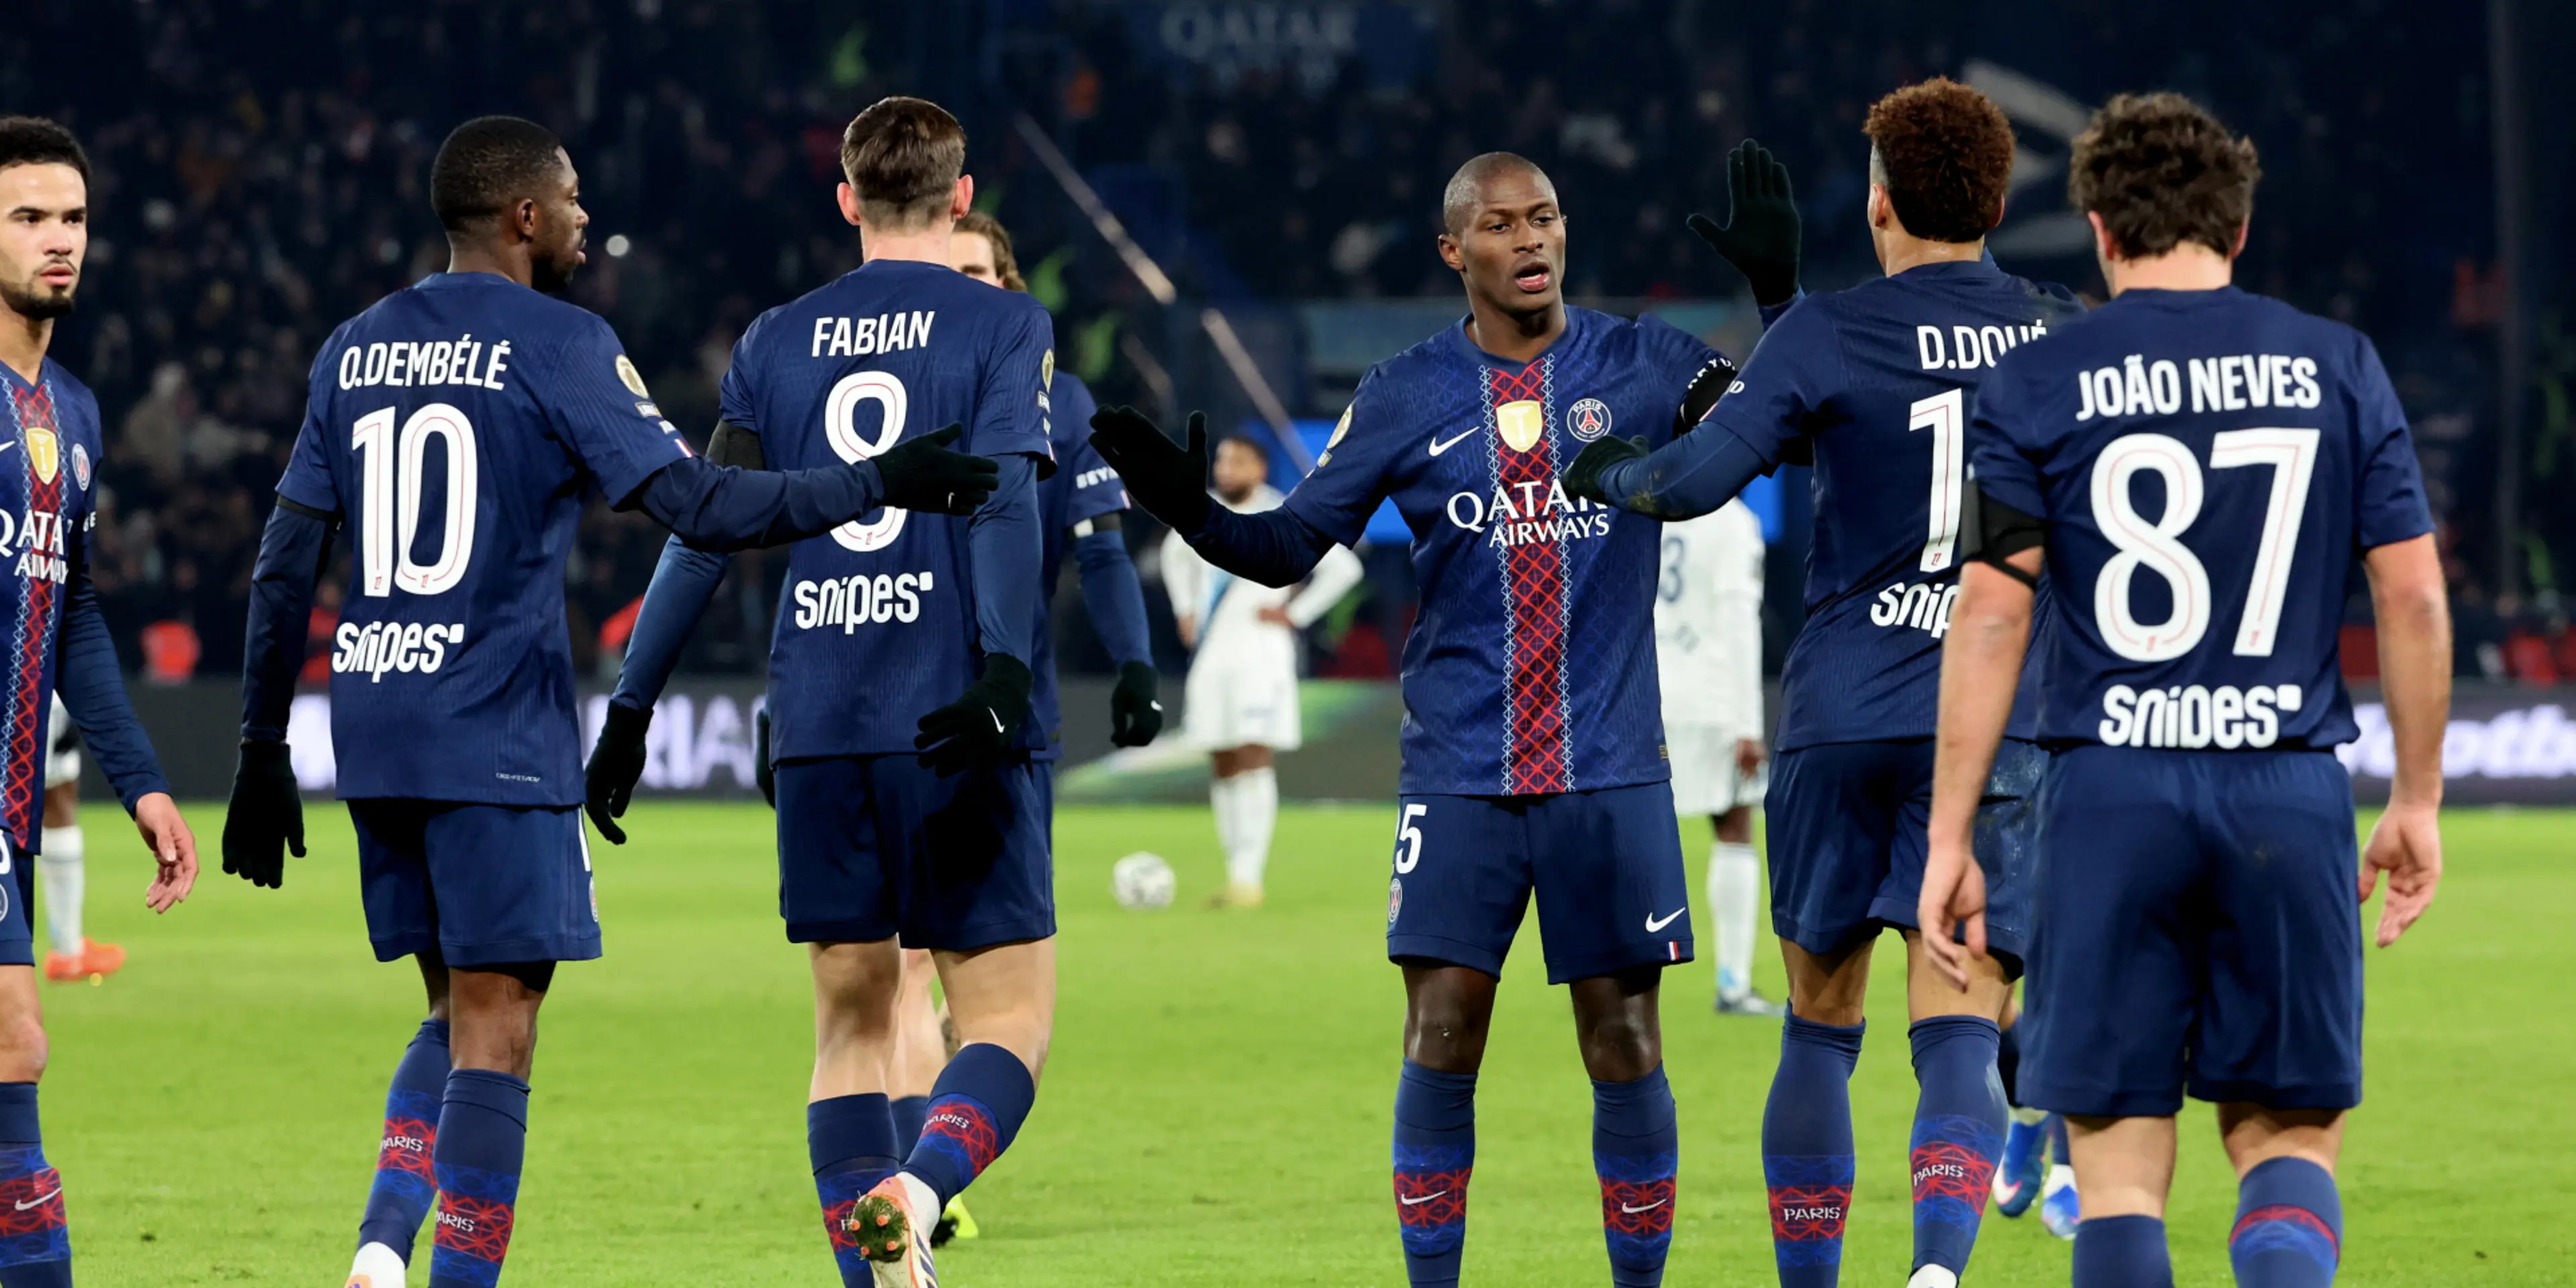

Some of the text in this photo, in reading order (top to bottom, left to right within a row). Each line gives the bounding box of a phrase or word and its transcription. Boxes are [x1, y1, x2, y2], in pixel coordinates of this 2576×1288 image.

[339, 333, 511, 390] O.DEMBÉLÉ
[812, 311, 935, 357] FABIAN
[2076, 354, 2320, 421] JOÃO NEVES
[824, 370, 908, 552] 8
[352, 402, 478, 597] 10
[1488, 513, 1610, 548] AIRWAYS
[2090, 427, 2320, 662] 87
[1870, 581, 1962, 639] snip
[1391, 804, 1428, 874] 5
[1913, 1164, 1964, 1187] PARIS
[1784, 1206, 1841, 1222] PARIS
